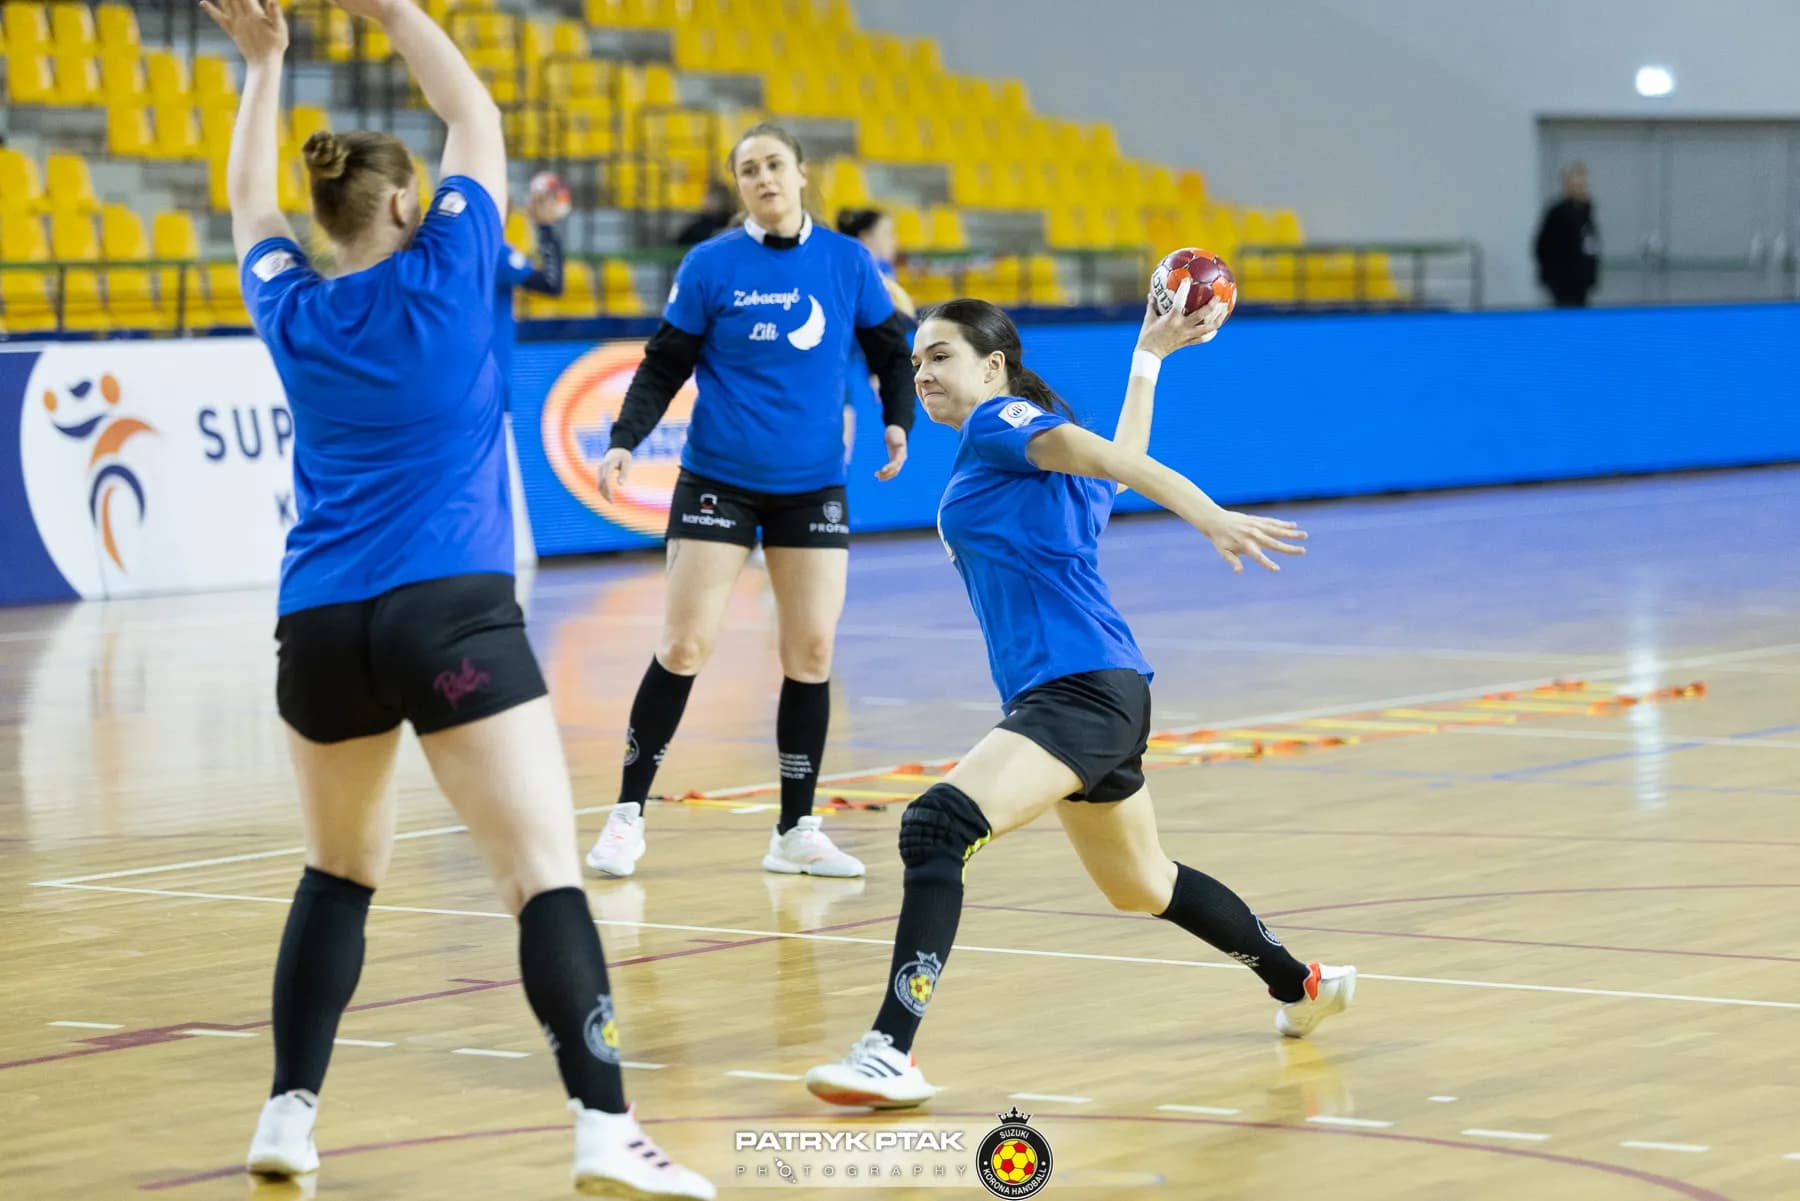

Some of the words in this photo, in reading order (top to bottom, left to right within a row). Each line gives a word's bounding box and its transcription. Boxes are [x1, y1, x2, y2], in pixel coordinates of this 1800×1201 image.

[733, 287, 800, 311] Zobaczyć
[1152, 271, 1174, 313] ELECT
[748, 322, 779, 341] Lili
